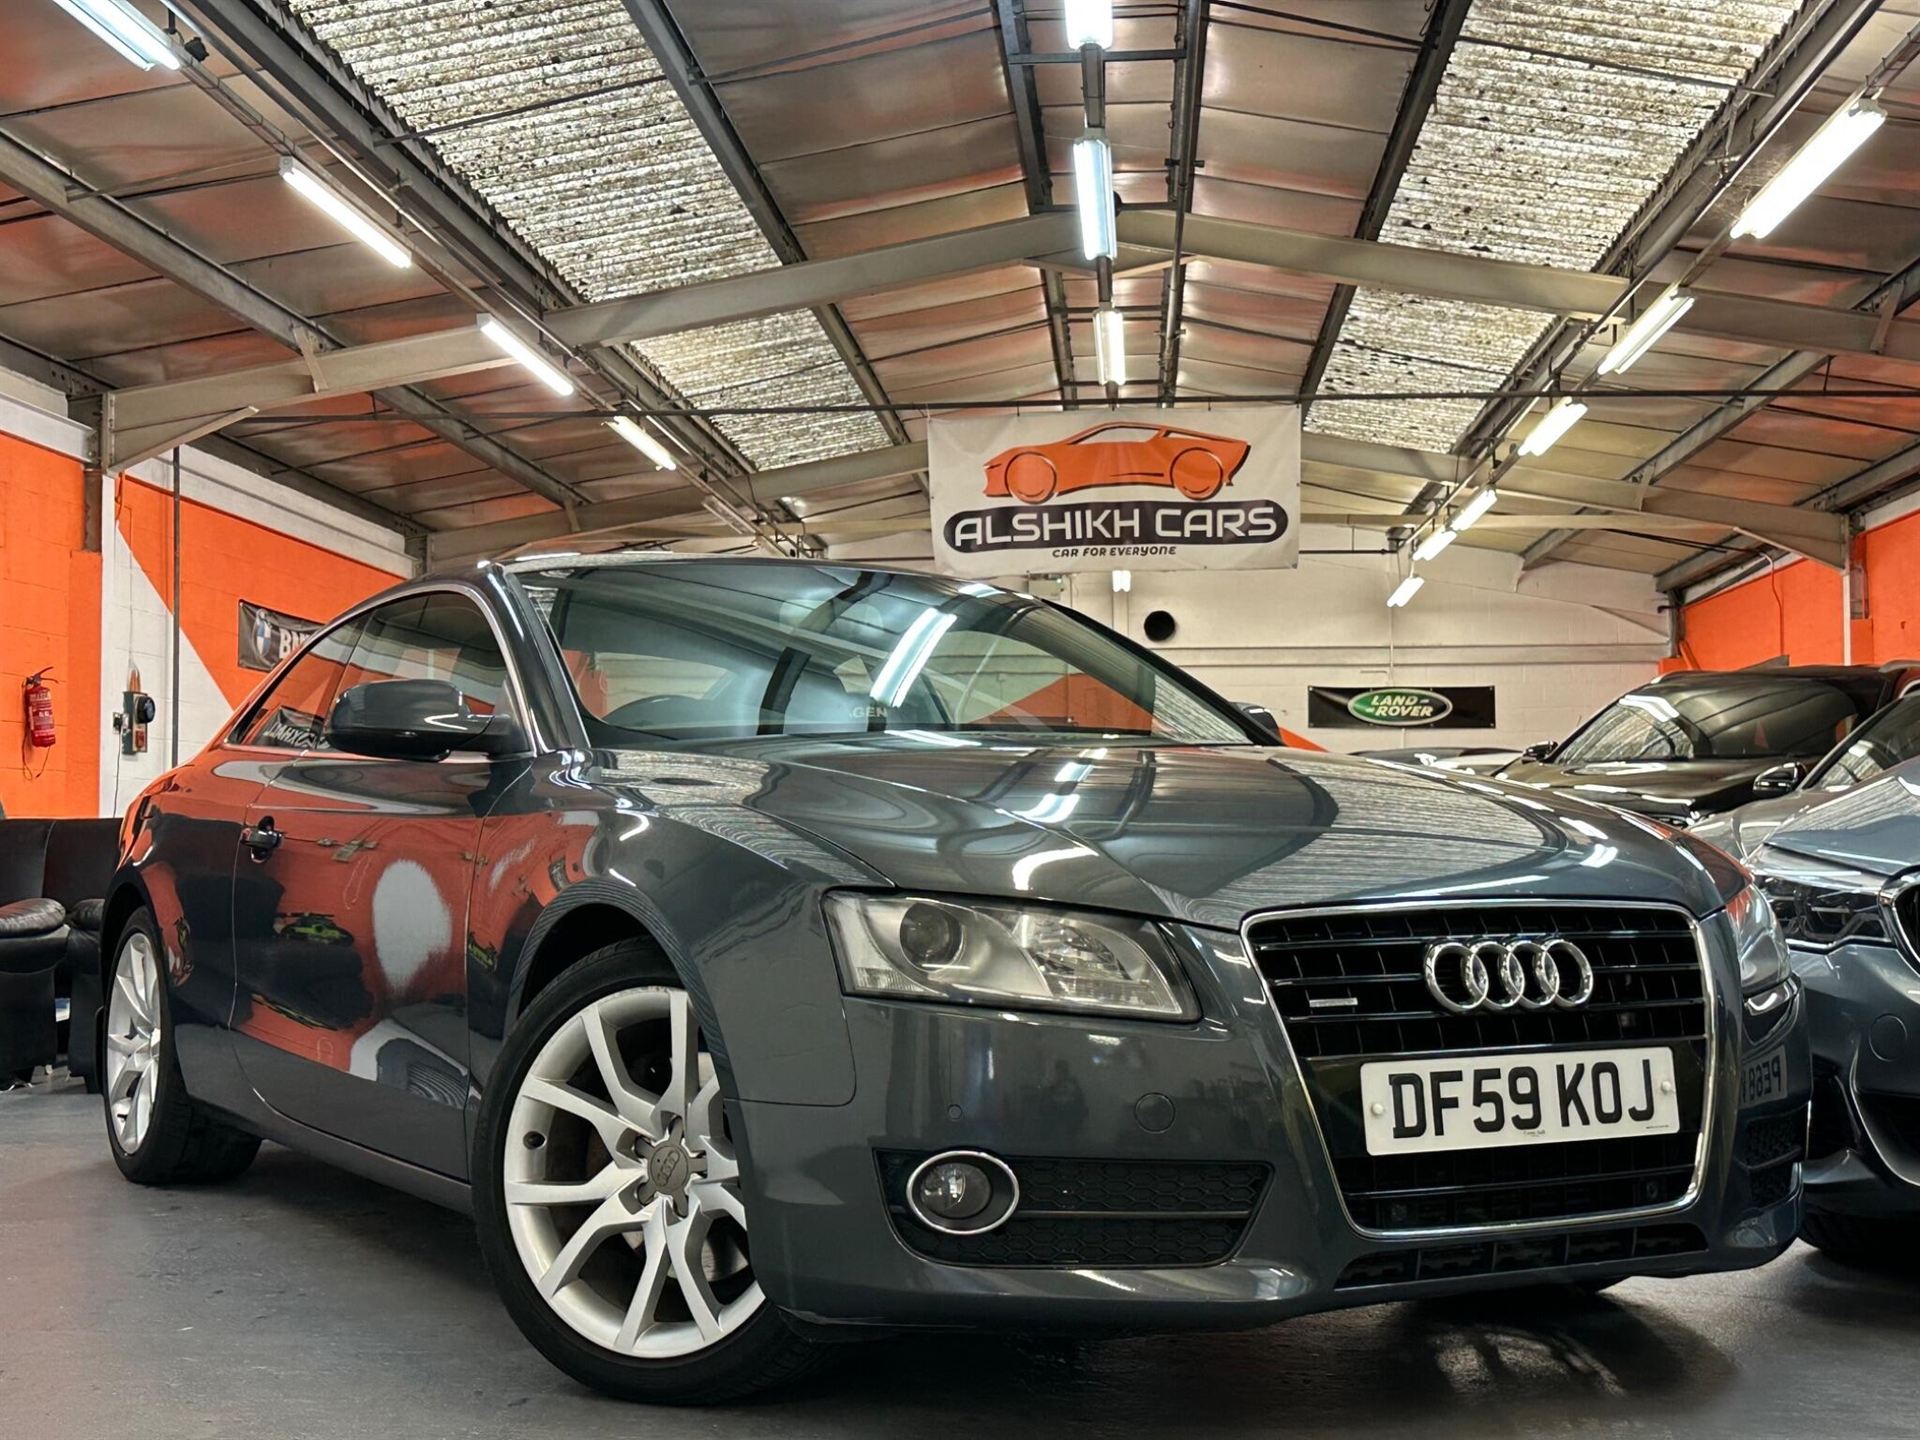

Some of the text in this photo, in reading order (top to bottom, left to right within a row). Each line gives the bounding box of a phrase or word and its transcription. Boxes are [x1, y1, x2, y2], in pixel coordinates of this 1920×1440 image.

[954, 506, 1277, 547] ALSHIKH CARS
[1052, 546, 1177, 558] CAR FOR EVERYONE
[279, 628, 311, 659] BM
[1371, 695, 1418, 706] LAND
[849, 706, 888, 718] GEN
[1375, 705, 1434, 717] ROVER
[1388, 1065, 1542, 1140] DF59
[1555, 1057, 1656, 1128] KOJ
